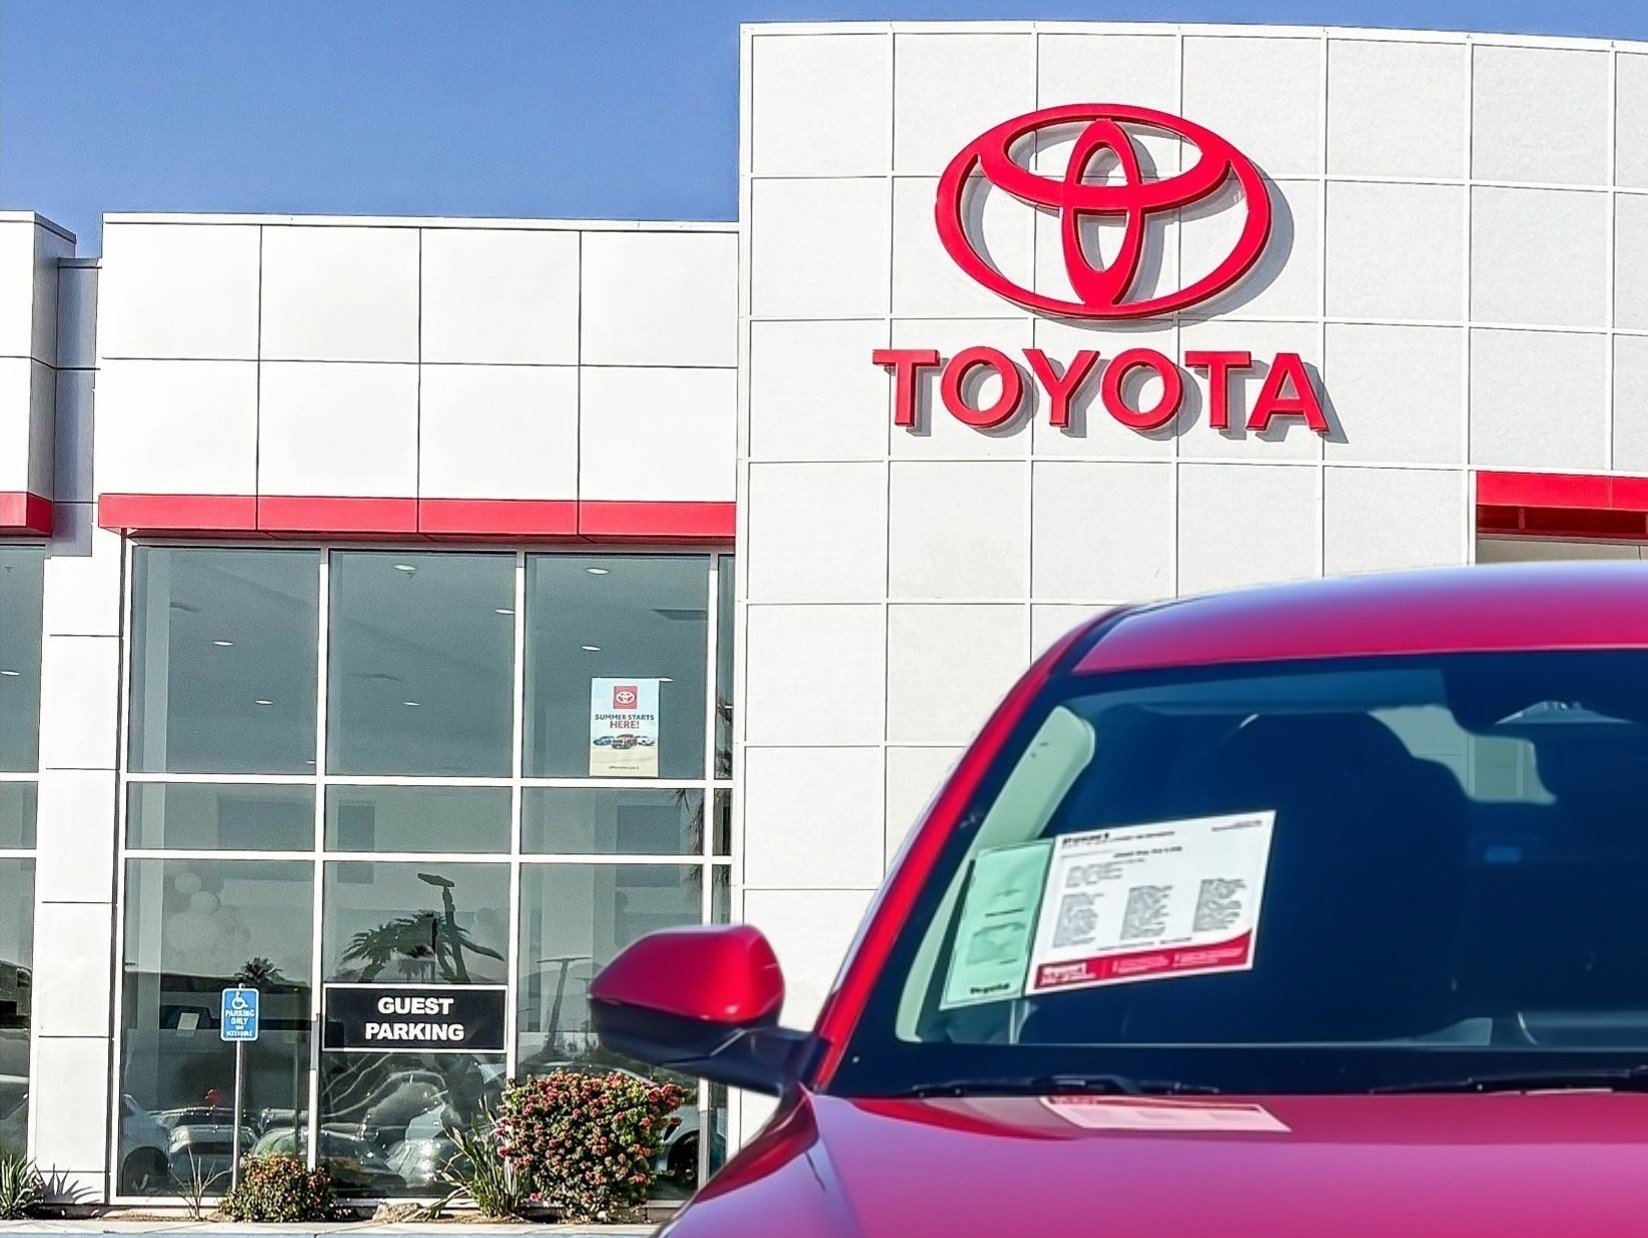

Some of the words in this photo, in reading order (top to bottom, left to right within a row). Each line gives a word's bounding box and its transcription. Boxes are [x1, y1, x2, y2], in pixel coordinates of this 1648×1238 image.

[872, 346, 1330, 433] TOYOTA
[609, 720, 640, 729] HERE!
[225, 1009, 255, 1017] PARKING
[377, 996, 454, 1015] GUEST
[365, 1022, 465, 1041] PARKING
